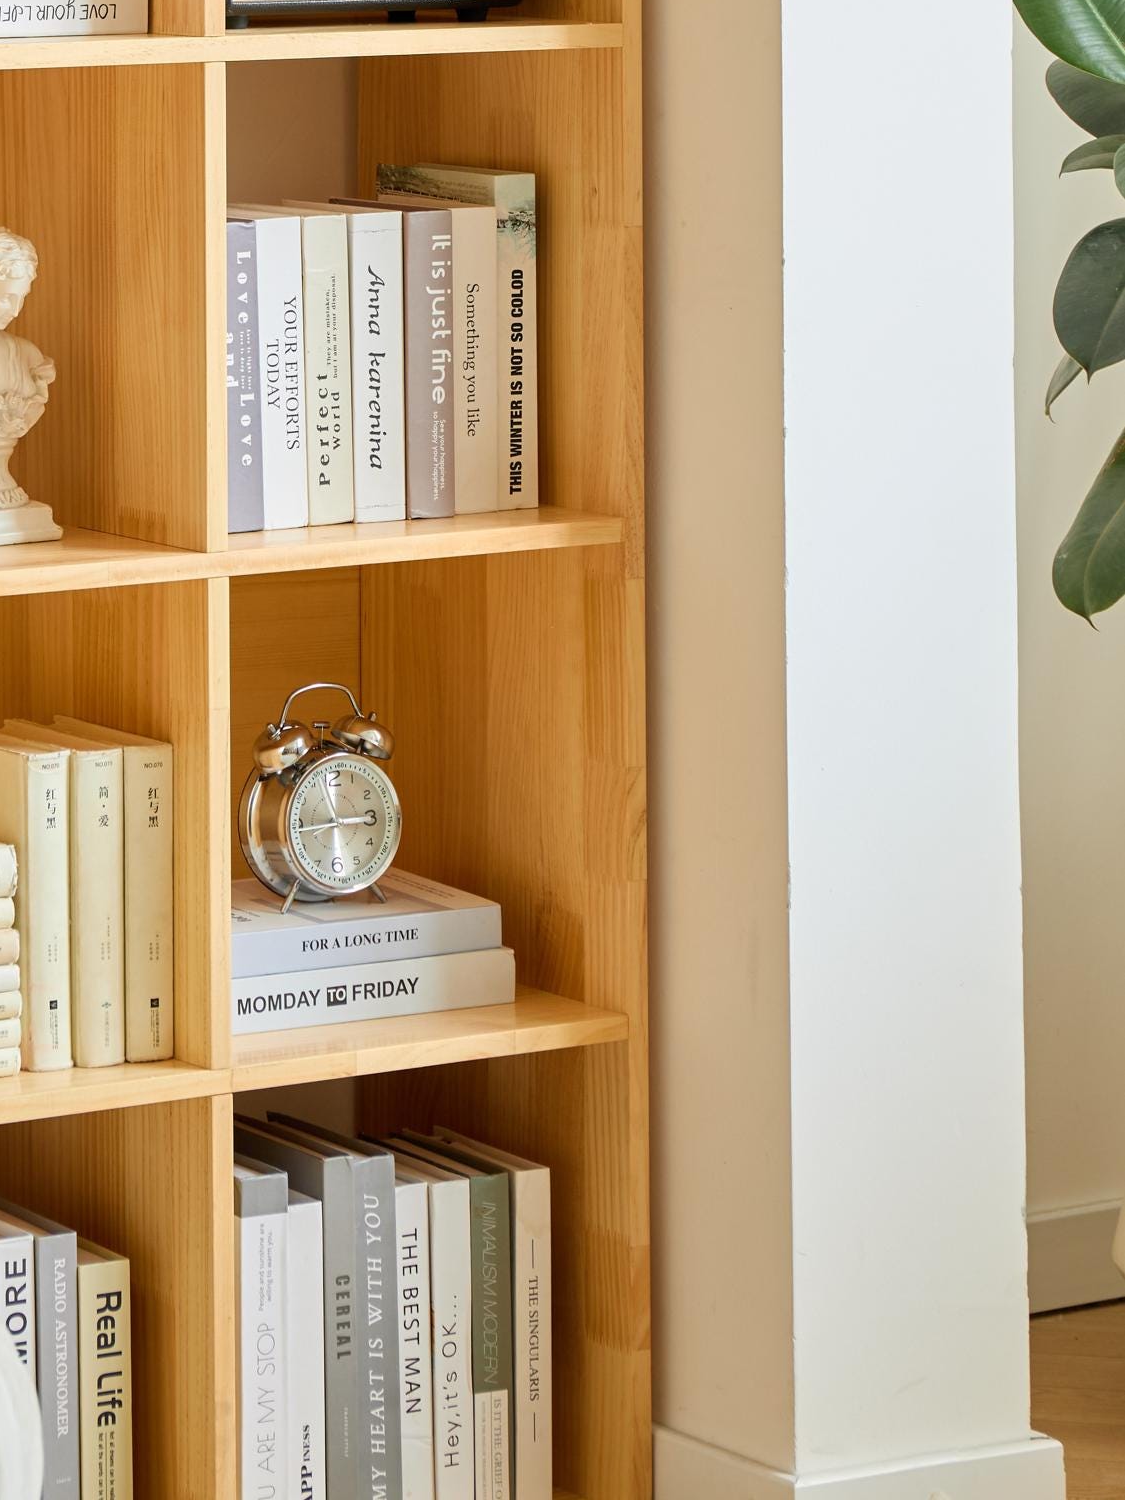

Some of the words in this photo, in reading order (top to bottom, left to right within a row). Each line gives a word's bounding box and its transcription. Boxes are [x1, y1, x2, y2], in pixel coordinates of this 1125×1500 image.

[80, 4, 116, 19] LOVE
[432, 235, 450, 250] It
[237, 251, 250, 323] Love
[432, 261, 450, 279] is
[511, 270, 523, 317] COLOD
[368, 265, 385, 335] Anna
[426, 286, 451, 339] just
[284, 297, 297, 354] YOUR
[463, 284, 479, 370] Something
[511, 323, 523, 342] SO
[267, 339, 280, 408] TODAY
[432, 350, 451, 404] fine
[511, 347, 522, 376] NOT
[285, 362, 299, 449] EFFORTS
[369, 353, 386, 469] karenina
[463, 376, 475, 402] you
[511, 381, 522, 395] IS
[240, 393, 254, 466] Love
[316, 374, 332, 486] Perfect
[331, 392, 340, 449] World
[468, 409, 480, 436] like
[510, 400, 522, 457] WINTER
[510, 461, 522, 495] THIS
[324, 770, 342, 787] 12
[364, 790, 371, 800] 2
[46, 788, 56, 829] 红与黑
[98, 786, 108, 827] 简·爱
[148, 787, 159, 828] 红与黑
[364, 810, 377, 826] 3
[332, 856, 344, 874] 6
[354, 856, 360, 865] 5
[366, 838, 373, 846] 4
[303, 939, 328, 951] FOR
[332, 936, 341, 948] A
[346, 933, 380, 947] LONG
[388, 929, 418, 942] TIME
[238, 989, 320, 1015] MOMDAY
[327, 986, 346, 1002] TO
[353, 977, 418, 1001] FRIDAY
[364, 1194, 381, 1244] YOU
[402, 1228, 418, 1276] THE
[55, 1258, 66, 1312] RADIO
[367, 1258, 382, 1325] WITH
[528, 1276, 538, 1306] THE
[97, 1291, 122, 1358] Real
[336, 1275, 351, 1359] CEREAL
[403, 1288, 419, 1345] BEST
[257, 1323, 275, 1375] STOP
[369, 1338, 383, 1358] IS
[482, 1300, 499, 1384] MODERN
[528, 1308, 540, 1402] SINGULARIS
[56, 1319, 68, 1438] ASTRONOMER
[97, 1371, 122, 1427] Life
[405, 1358, 421, 1413] MAN
[257, 1387, 275, 1423] MY
[369, 1370, 385, 1454] HEART
[257, 1432, 275, 1473] ARE
